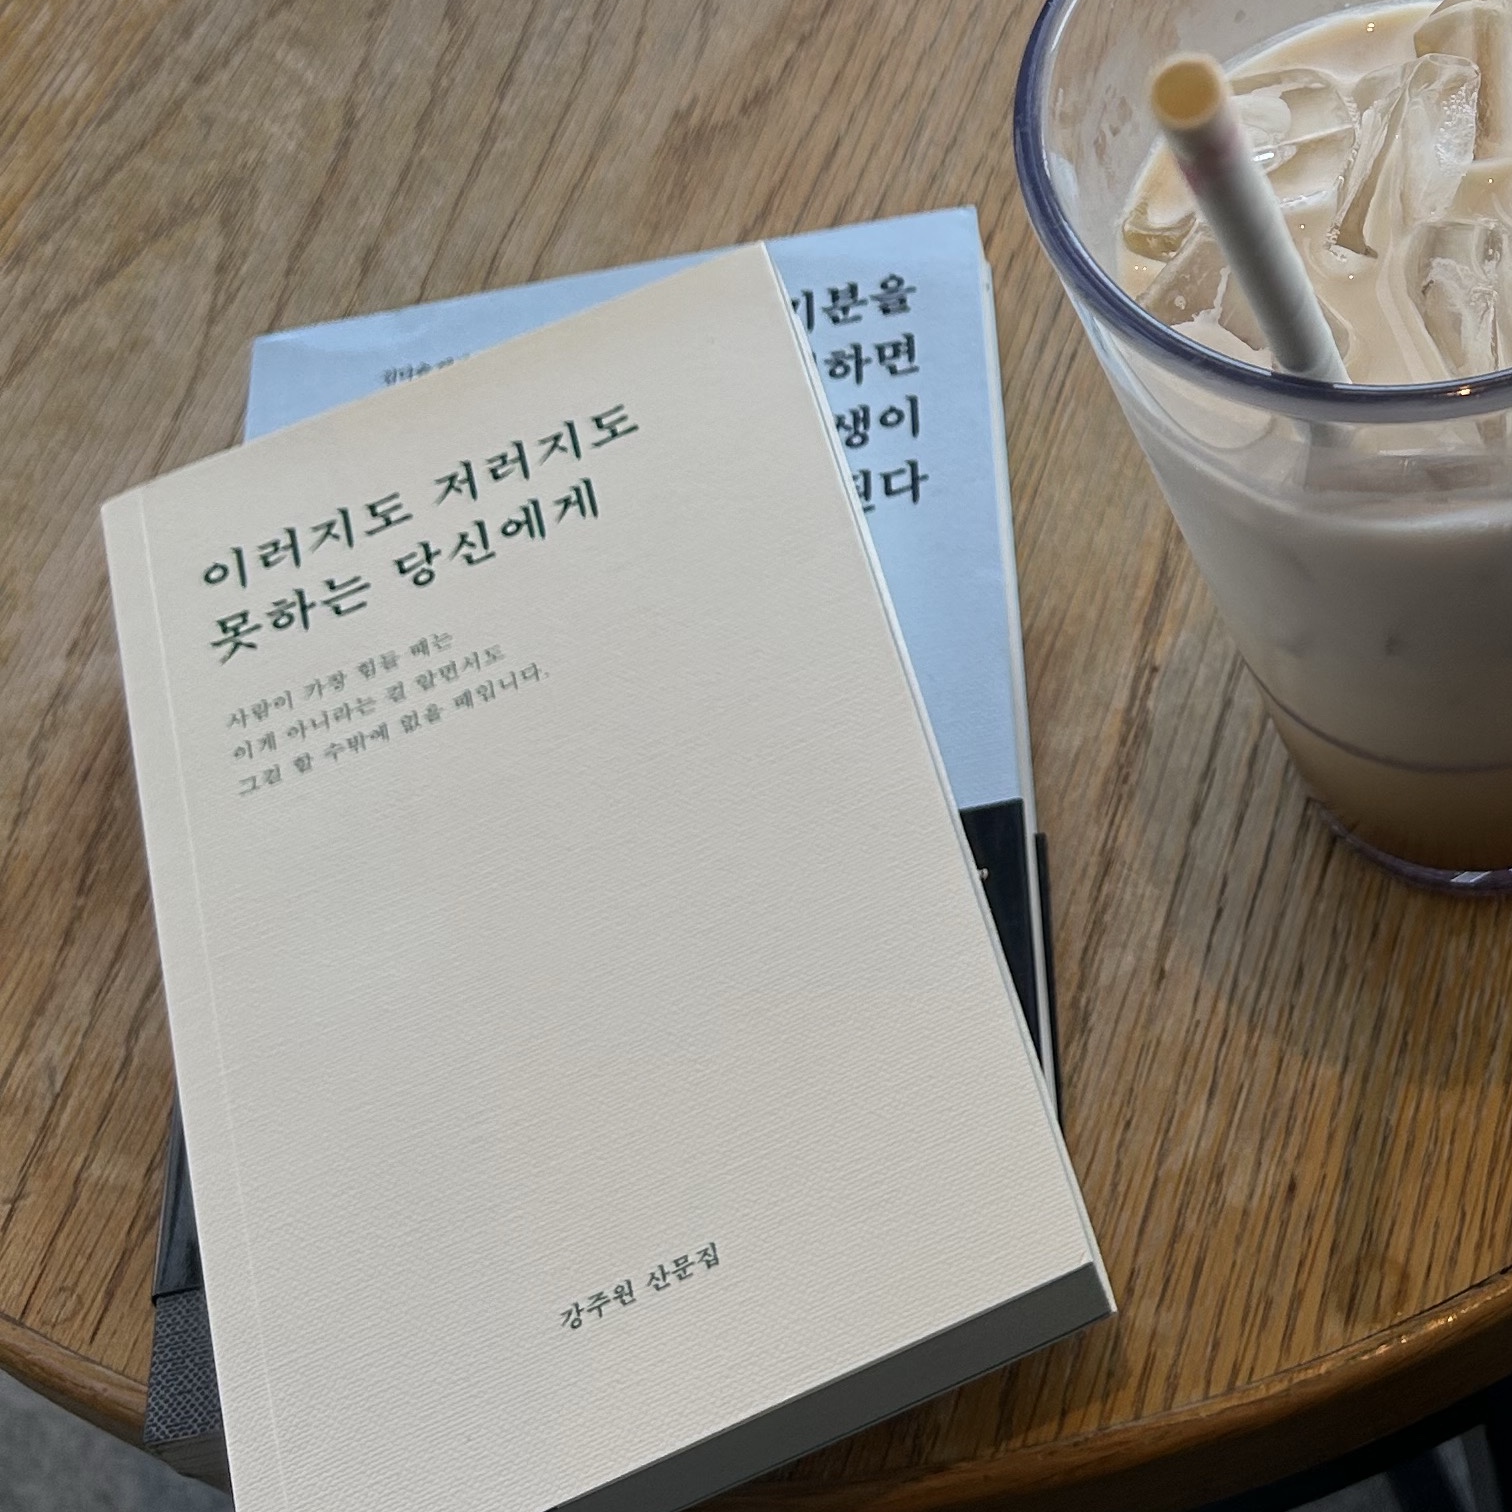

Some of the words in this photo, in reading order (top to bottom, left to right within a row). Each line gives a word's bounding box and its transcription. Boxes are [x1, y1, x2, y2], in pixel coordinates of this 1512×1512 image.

[813, 332, 920, 386] 하면
[203, 490, 414, 589] 이러지도
[433, 403, 640, 506] 저러지도
[210, 575, 372, 666] 못하는
[393, 477, 599, 588] 당신에게
[226, 689, 293, 730] 사람이
[303, 670, 348, 700] 가장
[357, 649, 400, 680] 힘들
[408, 631, 453, 657] 때는
[233, 730, 277, 759] 이게
[286, 695, 377, 741] 아니라는
[385, 680, 406, 703] 걸
[415, 643, 506, 691] 알면서도
[293, 751, 314, 774] 할
[324, 721, 390, 762] 수밖에
[400, 703, 445, 734] 없을
[452, 661, 550, 709] 때입니다.
[560, 1279, 637, 1329] 강주원
[646, 1242, 720, 1292] 산문집
